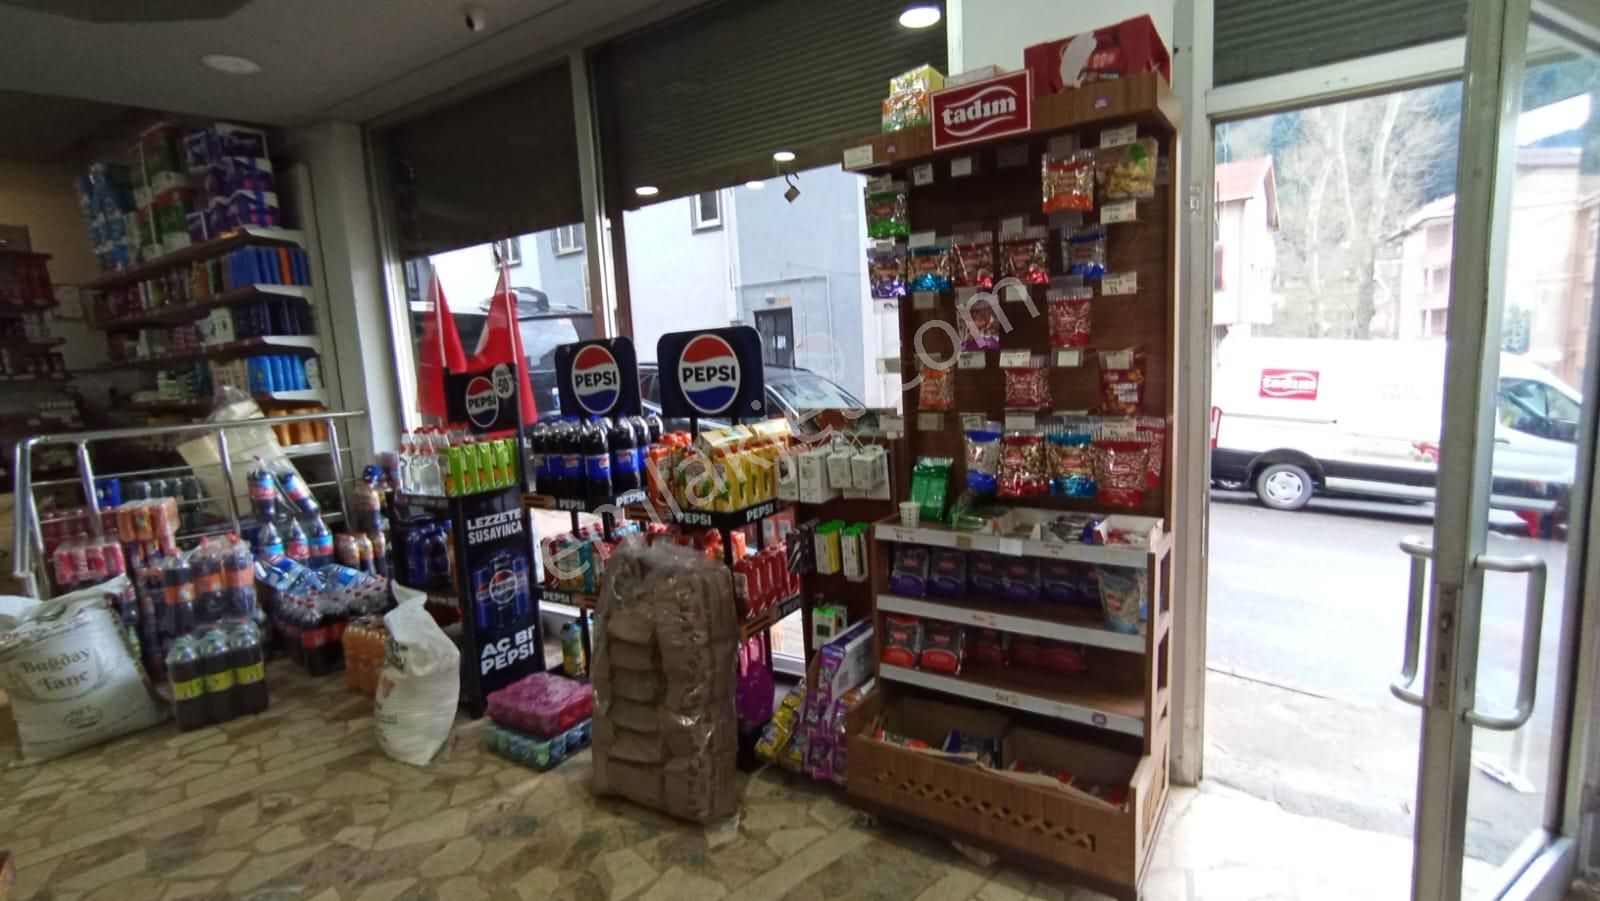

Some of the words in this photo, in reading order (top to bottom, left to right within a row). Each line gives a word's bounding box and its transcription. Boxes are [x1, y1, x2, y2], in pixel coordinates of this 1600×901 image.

[942, 96, 1017, 127] tadım
[574, 371, 618, 389] PEPSI
[683, 364, 736, 383] PEPSI
[468, 395, 496, 411] PEPSI
[558, 499, 586, 510] PEPSI
[616, 490, 647, 507] PEPSI
[467, 509, 521, 529] LEZZETE
[677, 512, 712, 526] PEPSI
[746, 502, 774, 522] PEPSI
[468, 521, 522, 544] SUSAYINCA
[543, 591, 570, 604] PEPSI
[481, 641, 535, 676] PEPSI
